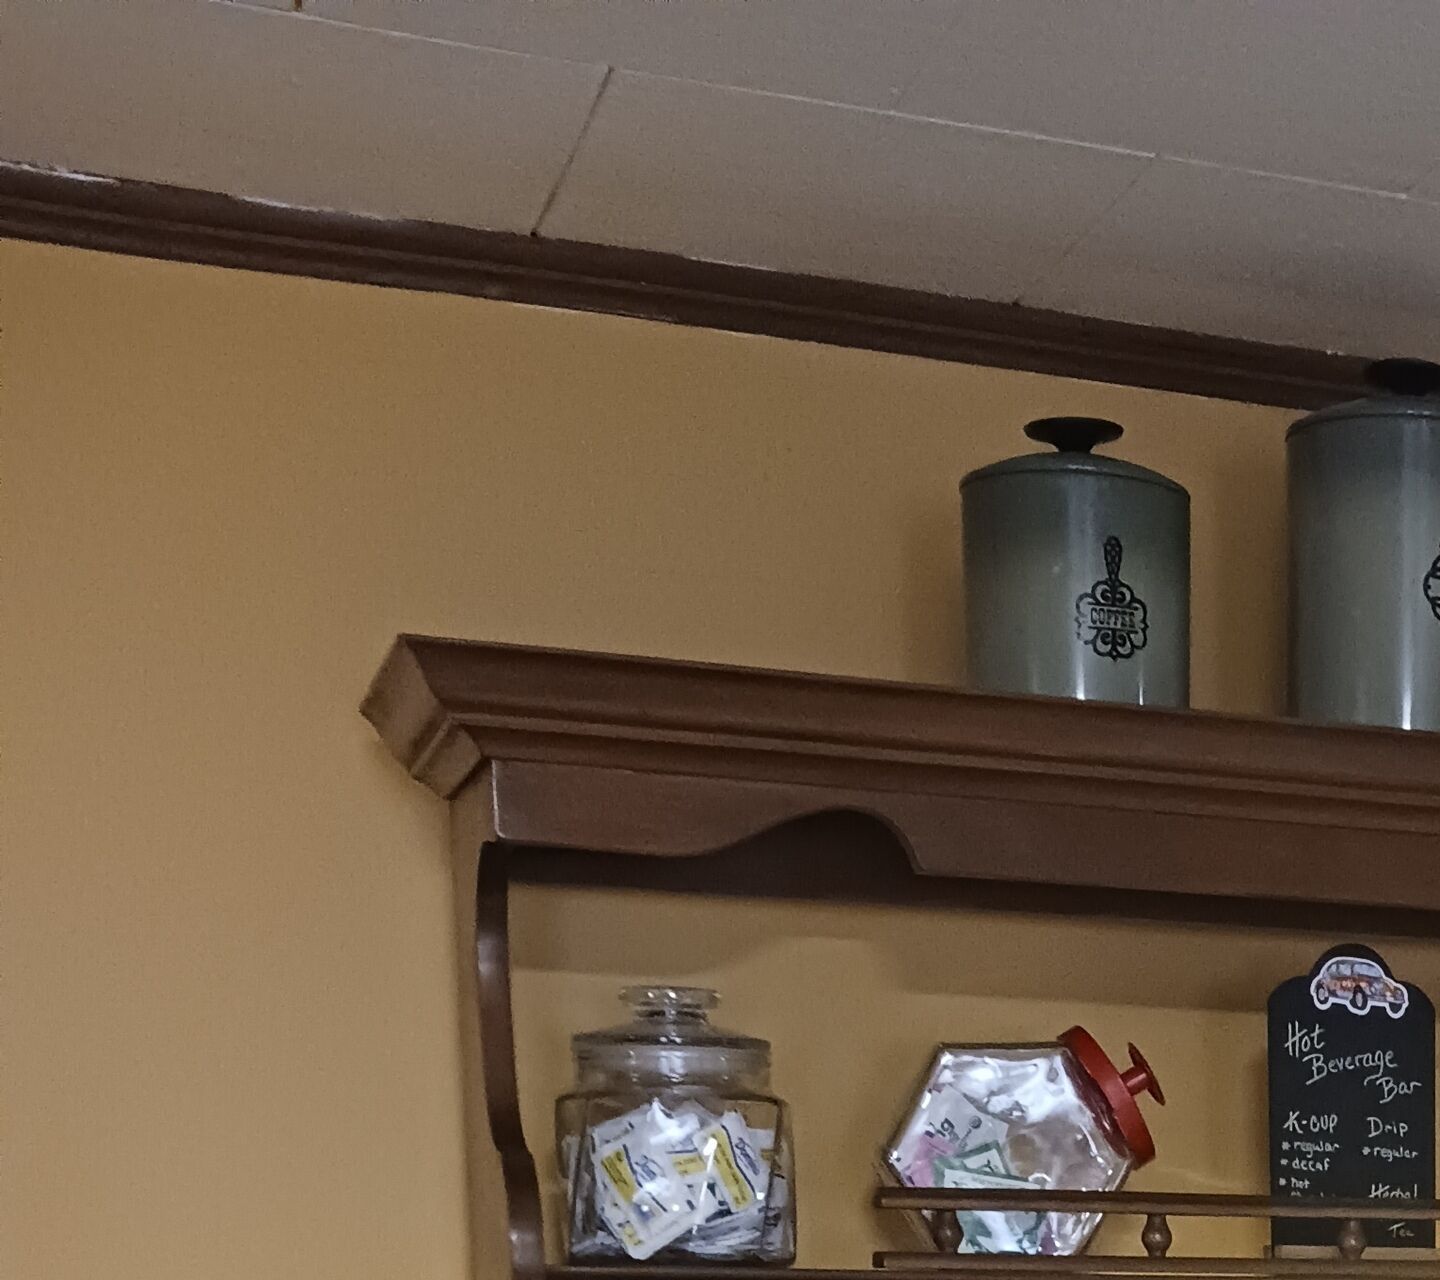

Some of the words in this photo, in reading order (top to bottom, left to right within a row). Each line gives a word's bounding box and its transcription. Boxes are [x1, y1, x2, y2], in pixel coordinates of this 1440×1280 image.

[1090, 607, 1137, 629] COFFEE
[1284, 1021, 1326, 1058] Hot
[1303, 1050, 1398, 1086] Beverage
[1374, 1076, 1422, 1104] Bar
[1366, 1116, 1409, 1138] Drip
[1291, 1158, 1331, 1172] decaf
